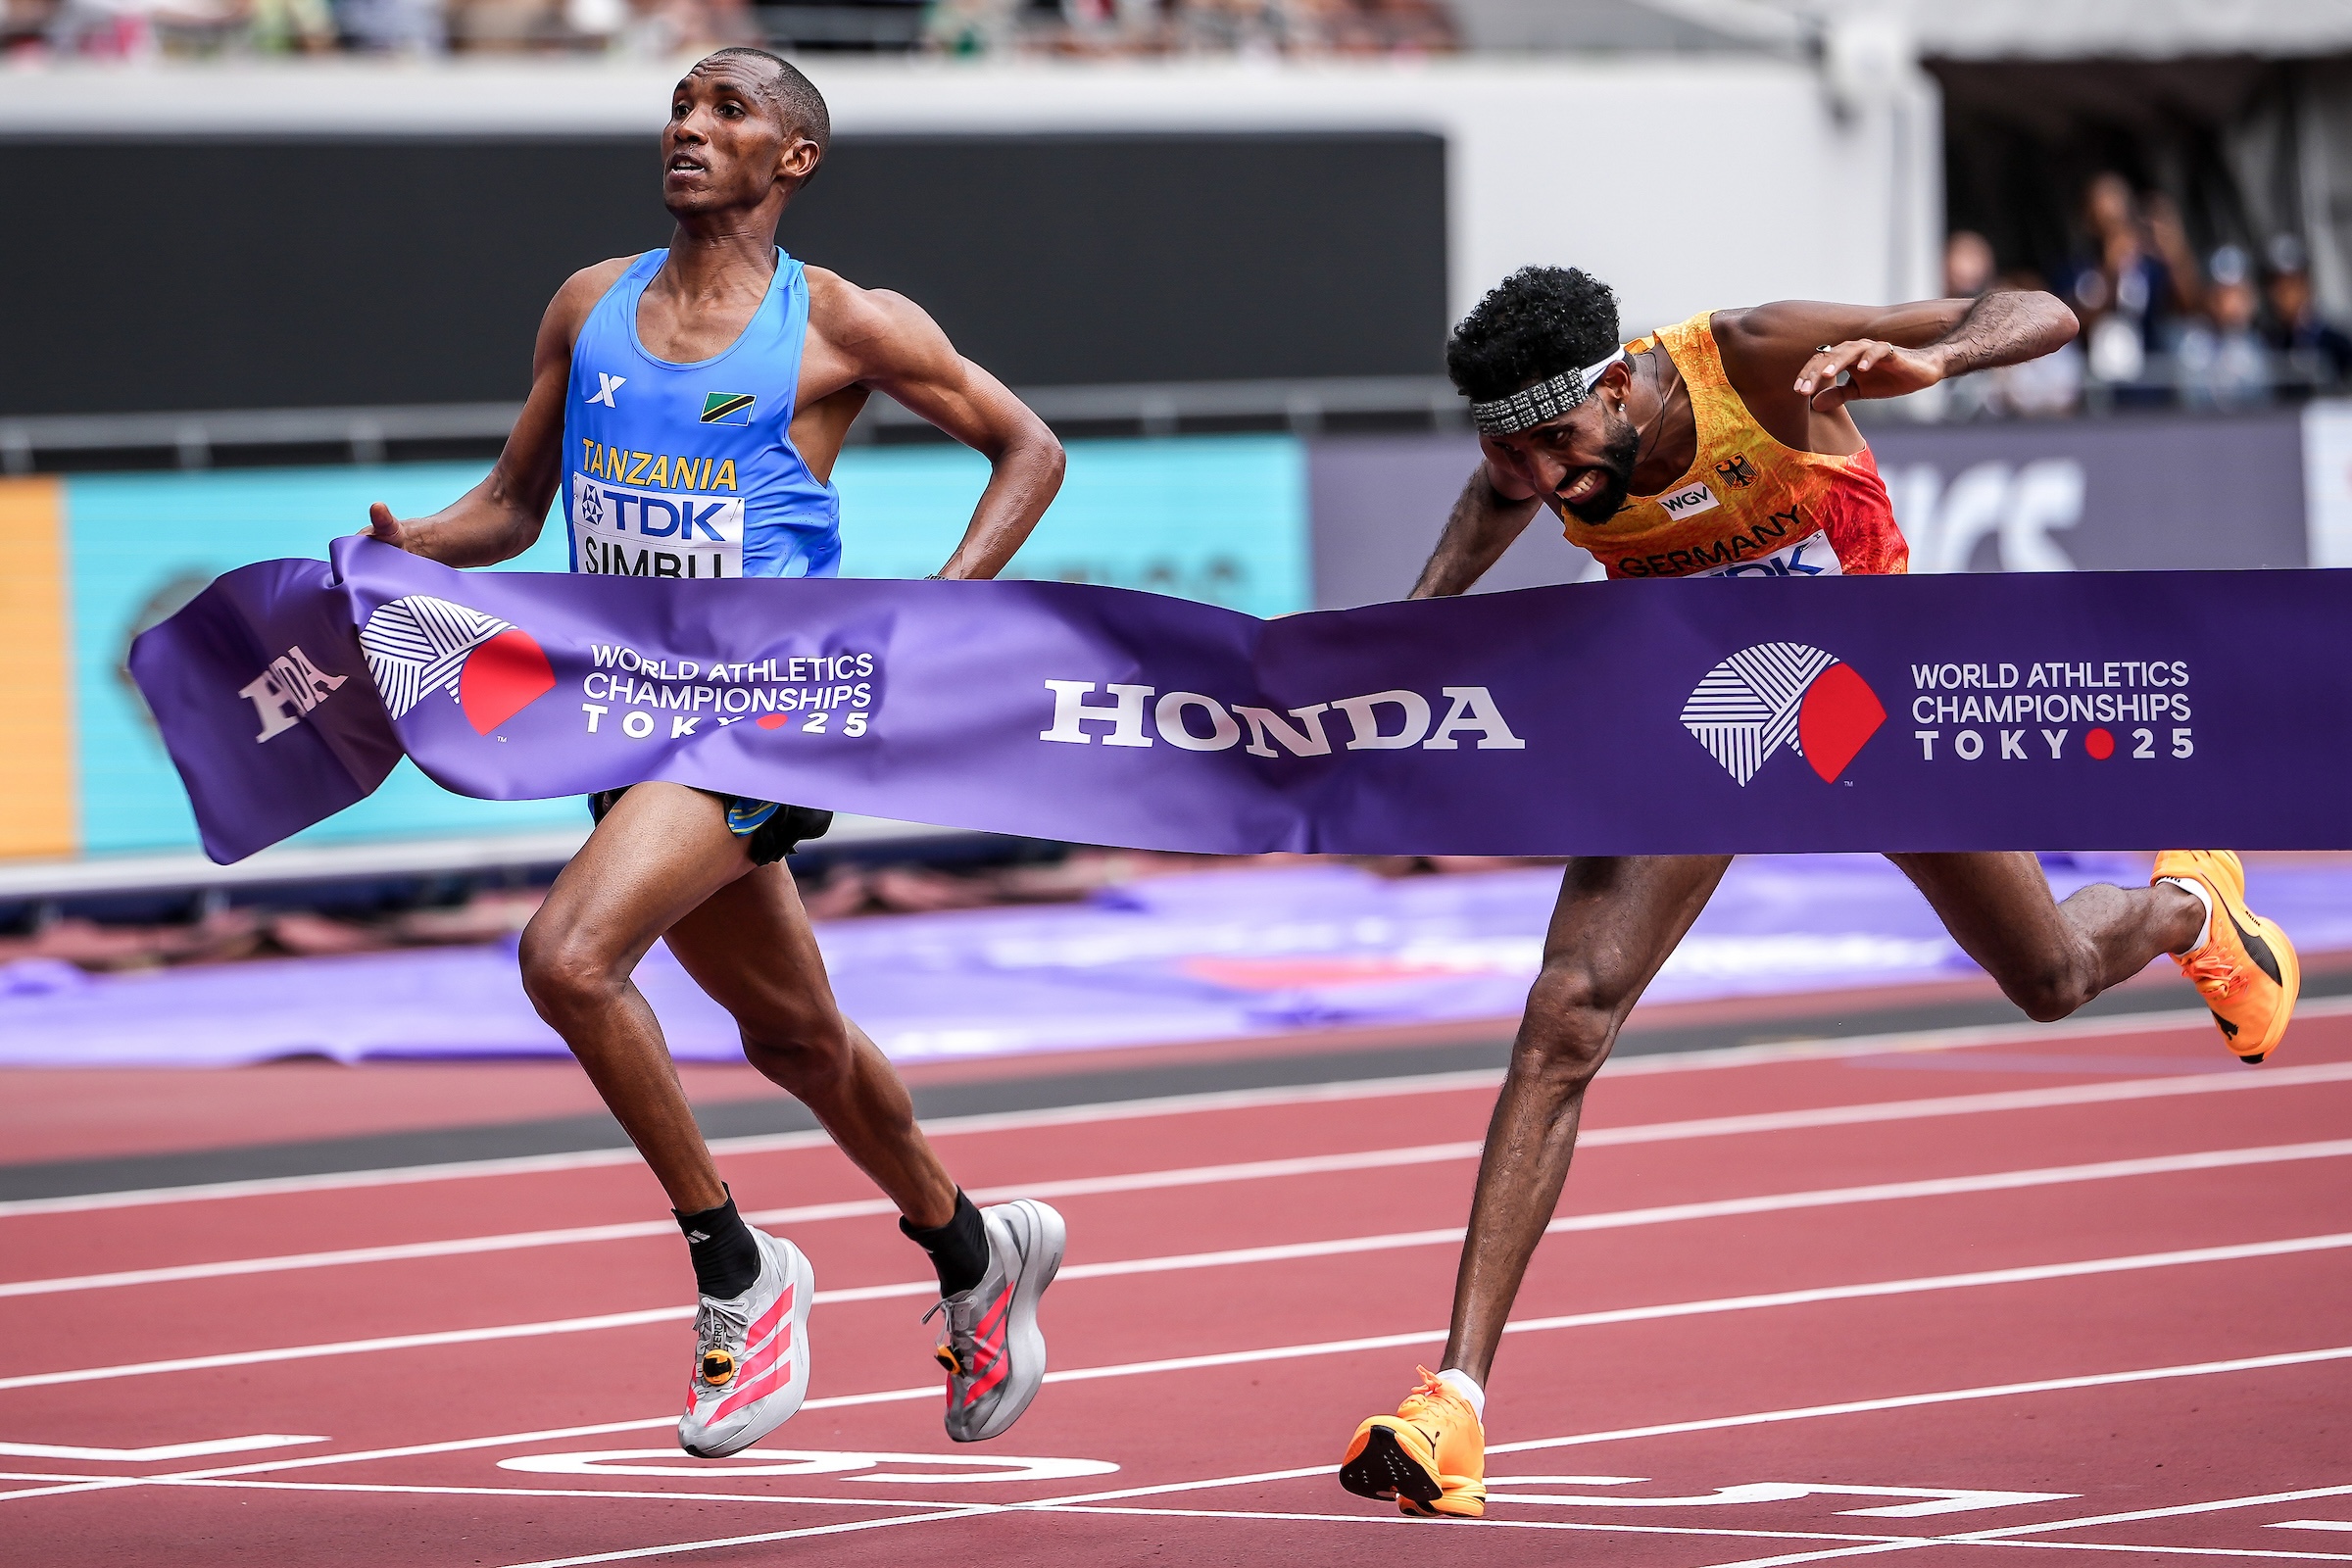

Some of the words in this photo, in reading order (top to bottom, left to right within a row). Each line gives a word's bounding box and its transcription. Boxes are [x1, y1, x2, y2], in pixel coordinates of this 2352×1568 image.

[583, 438, 737, 491] TANZANIA
[603, 490, 726, 541] TDK
[1661, 486, 1708, 512] WGV
[1618, 504, 1800, 577] GERMANY
[590, 644, 700, 680] WORLD
[707, 653, 874, 683] ATHLETICS
[1911, 663, 2019, 690] WORLD
[2027, 662, 2189, 688] ATHLETICS
[583, 672, 872, 713] CHAMPIONSHIPS
[1912, 694, 2192, 724] CHAMPIONSHIPS
[802, 711, 869, 739] 25
[1039, 679, 1526, 758] HONDA
[2132, 728, 2194, 760] 25
